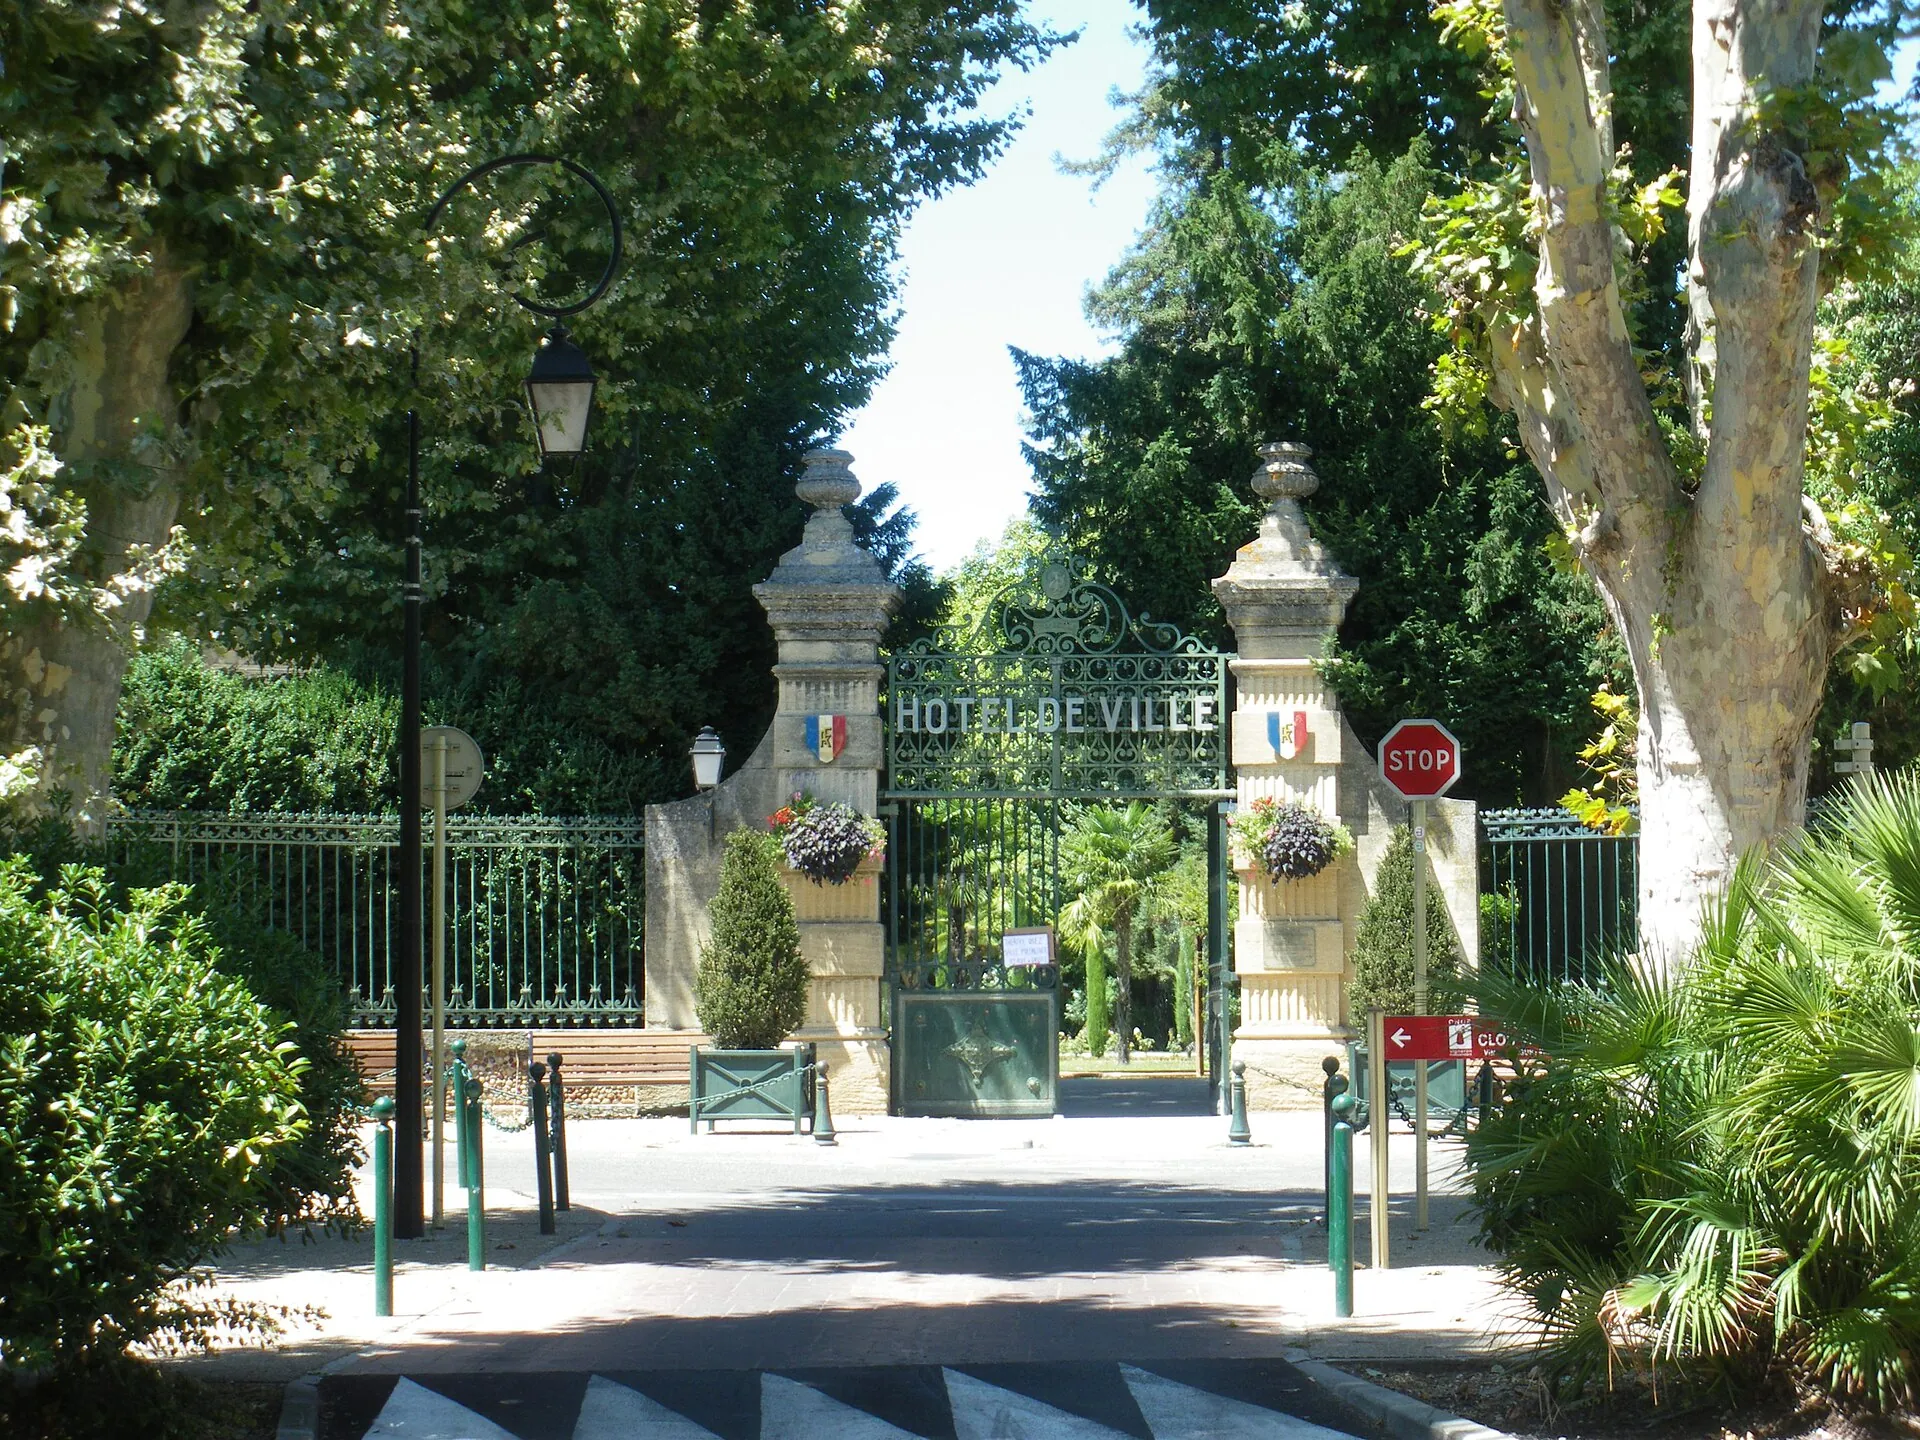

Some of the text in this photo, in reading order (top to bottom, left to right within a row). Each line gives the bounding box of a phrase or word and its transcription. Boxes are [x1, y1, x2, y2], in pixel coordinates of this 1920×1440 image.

[897, 695, 1214, 735] HOTEL DE VILLE
[1389, 749, 1450, 771] STOP
